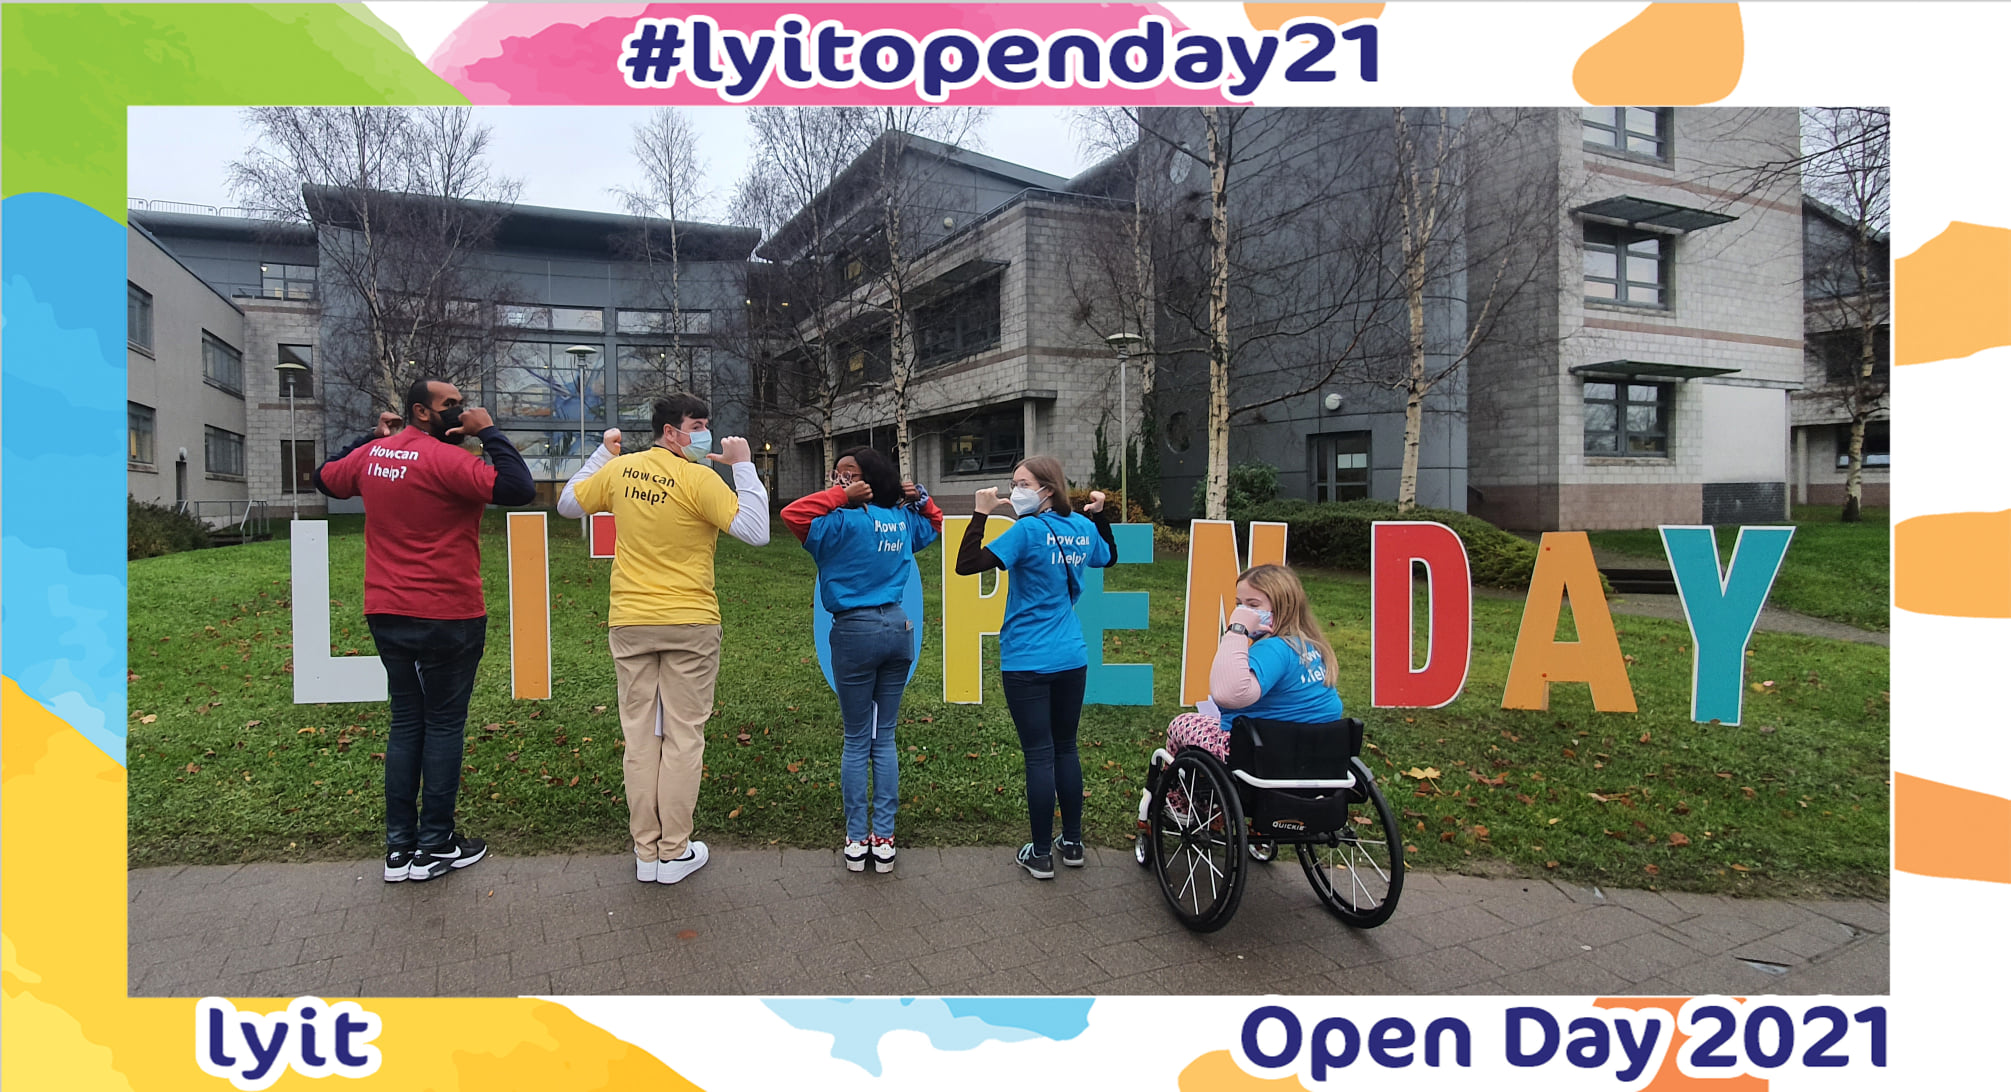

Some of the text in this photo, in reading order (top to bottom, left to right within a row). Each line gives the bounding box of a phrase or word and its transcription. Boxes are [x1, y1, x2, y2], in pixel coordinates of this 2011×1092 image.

[369, 445, 419, 461] How can
[367, 463, 407, 482] I help?
[622, 467, 675, 488] How can
[624, 485, 667, 506] I help?
[874, 519, 897, 533] How
[1046, 532, 1074, 546] How
[1051, 551, 1087, 568] I help?
[1371, 520, 1797, 727] DAY
[1272, 820, 1305, 832] QUICKIE
